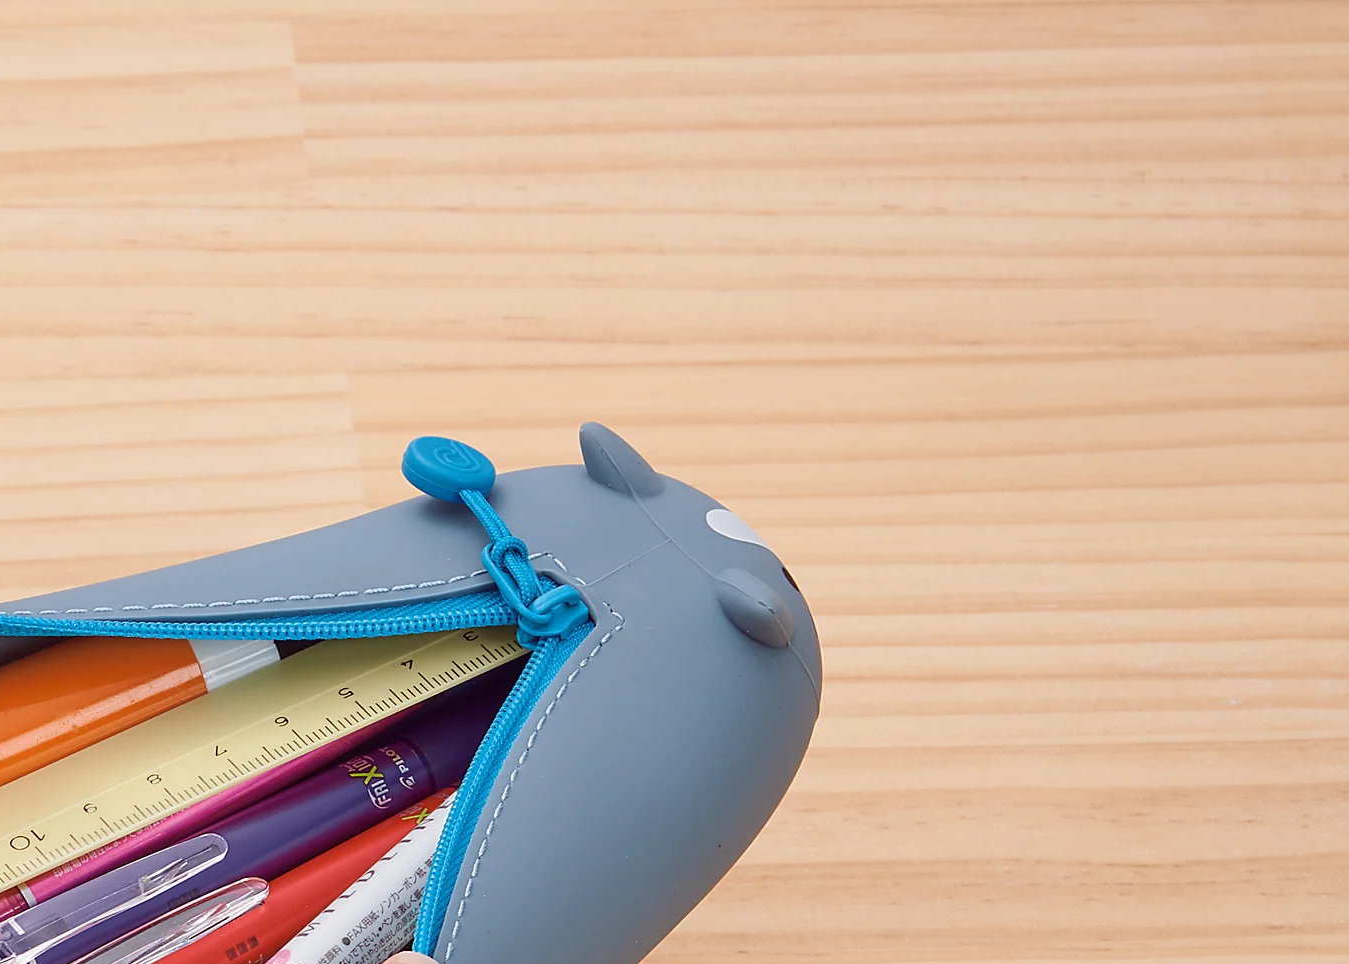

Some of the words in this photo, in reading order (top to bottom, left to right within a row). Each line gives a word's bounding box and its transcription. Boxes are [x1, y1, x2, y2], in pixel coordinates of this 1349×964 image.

[462, 630, 481, 643] 3
[398, 659, 414, 671] 4
[338, 687, 354, 701] 5
[275, 716, 290, 729] 6
[215, 745, 228, 758] 7
[379, 746, 410, 774] PILOT
[147, 774, 162, 786] 8
[83, 803, 97, 816] 9
[9, 830, 46, 852] 10
